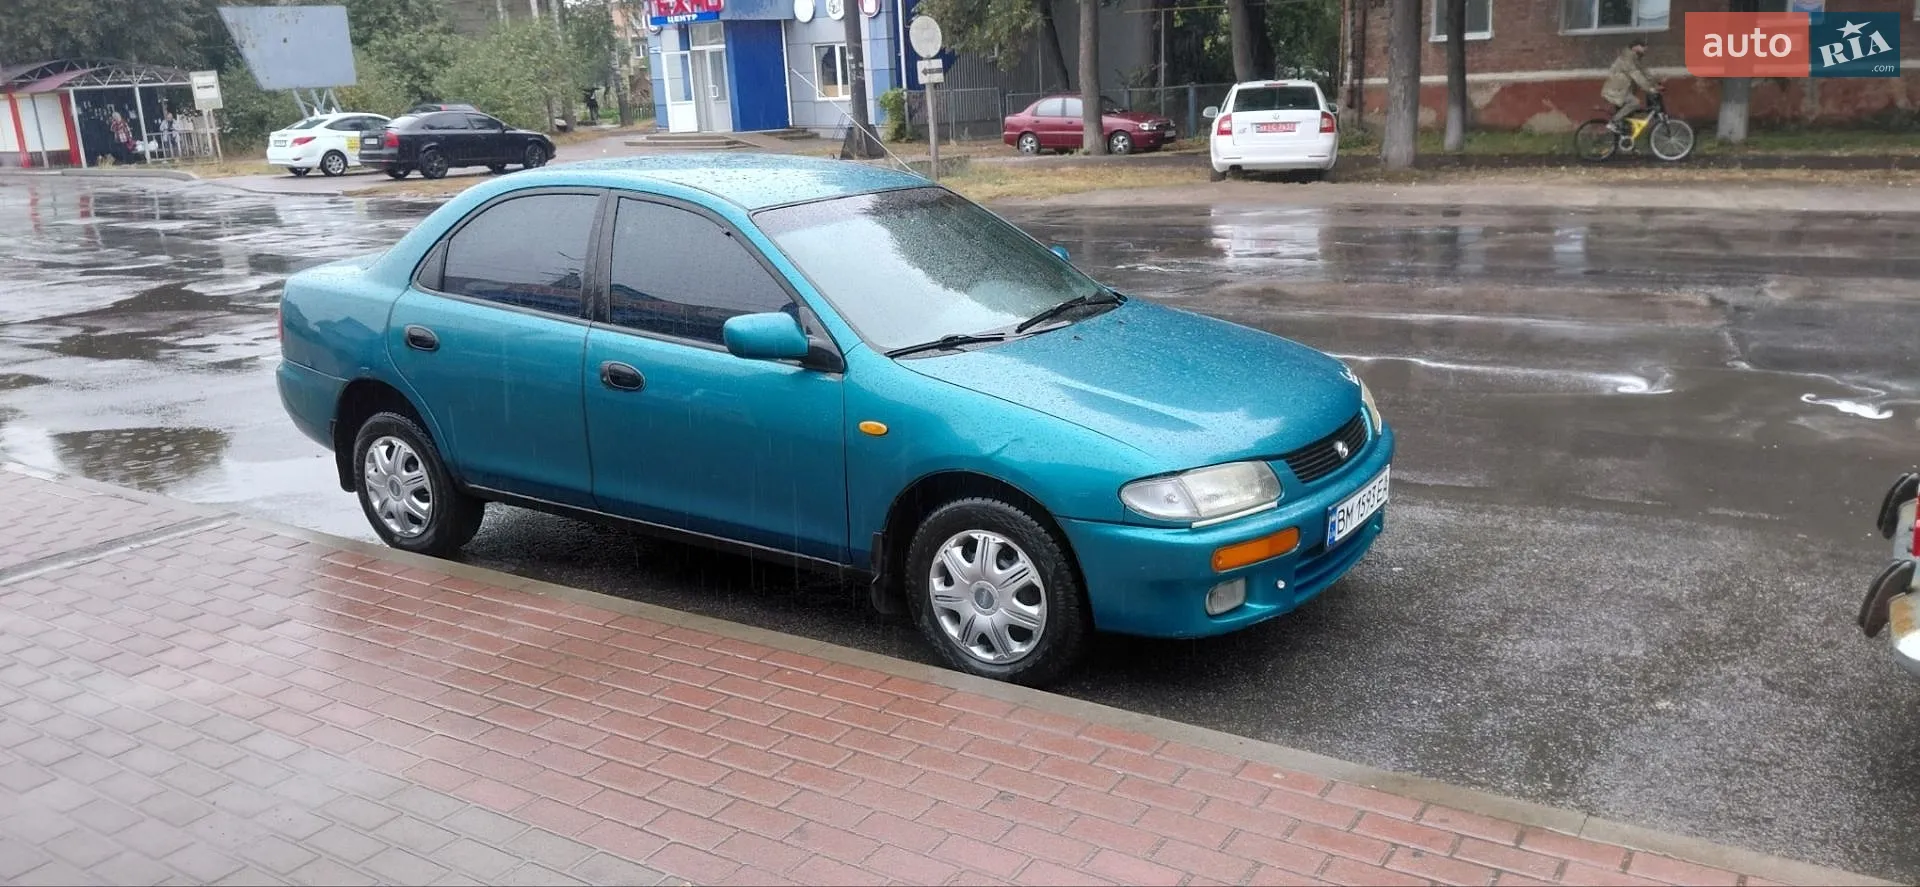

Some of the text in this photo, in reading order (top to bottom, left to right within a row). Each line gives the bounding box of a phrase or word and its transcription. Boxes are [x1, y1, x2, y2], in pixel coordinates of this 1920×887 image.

[667, 14, 698, 23] ЦЕНТР
[1337, 502, 1354, 534] BM
[1357, 485, 1376, 520] 1593
